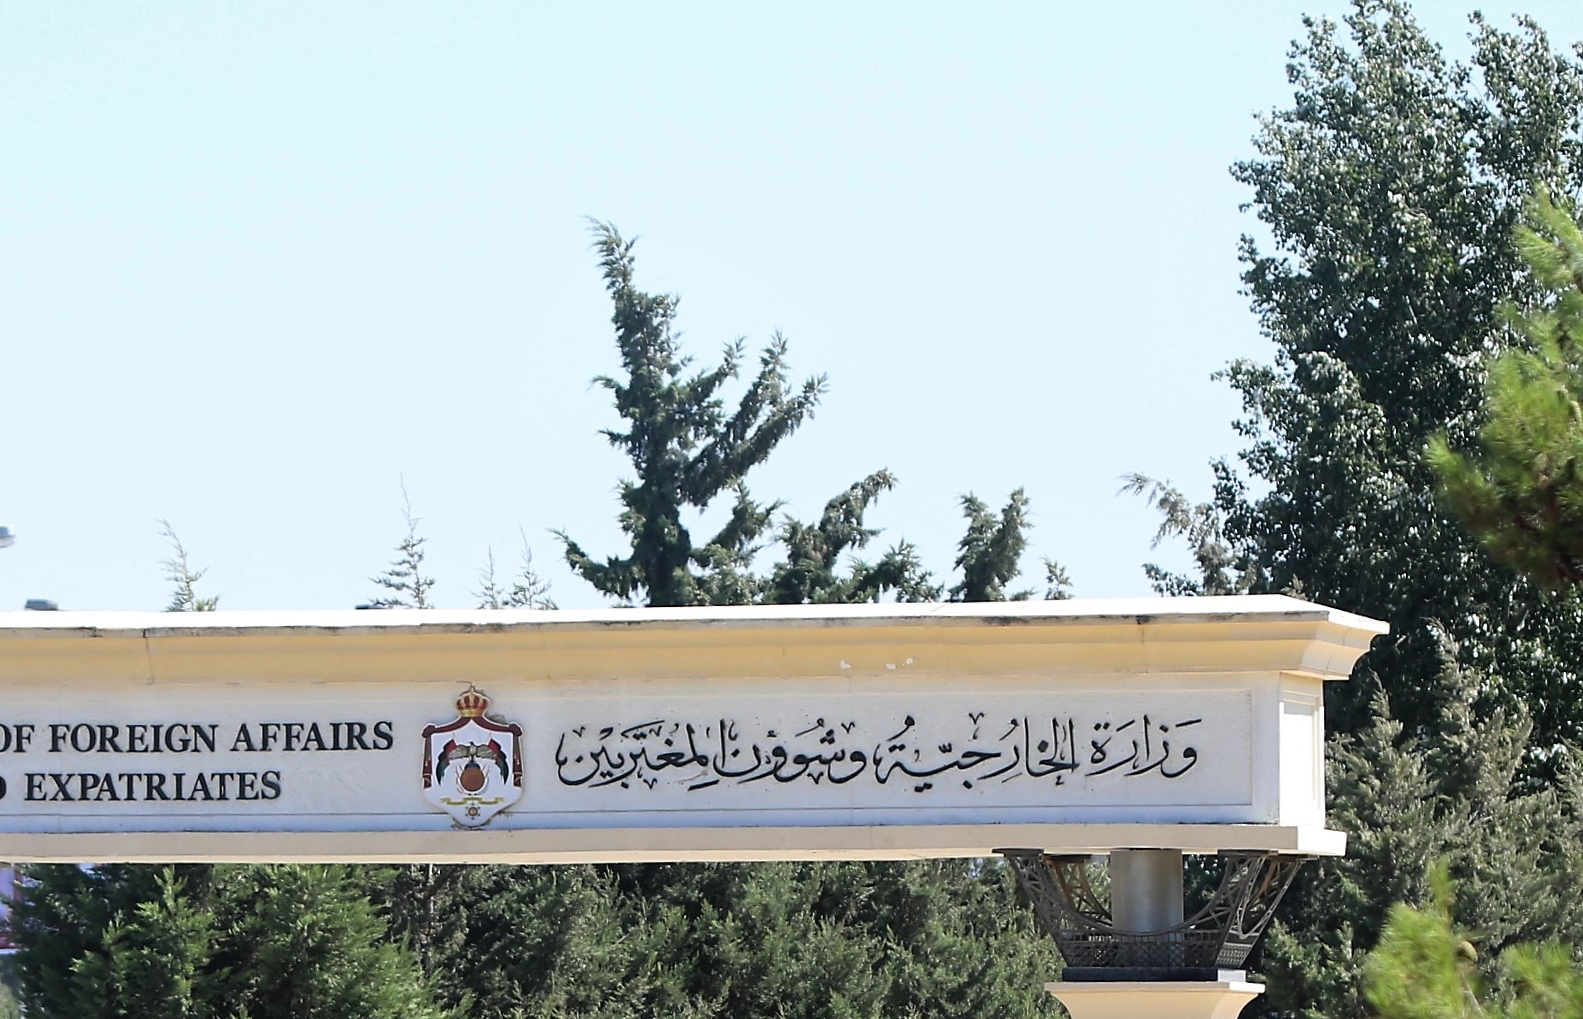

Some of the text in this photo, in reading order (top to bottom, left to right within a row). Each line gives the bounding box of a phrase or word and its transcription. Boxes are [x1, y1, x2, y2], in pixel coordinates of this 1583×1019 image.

[47, 722, 219, 754] FOREIGN
[229, 720, 394, 752] AFFAIRS
[23, 770, 282, 802] EXPATRIATES
